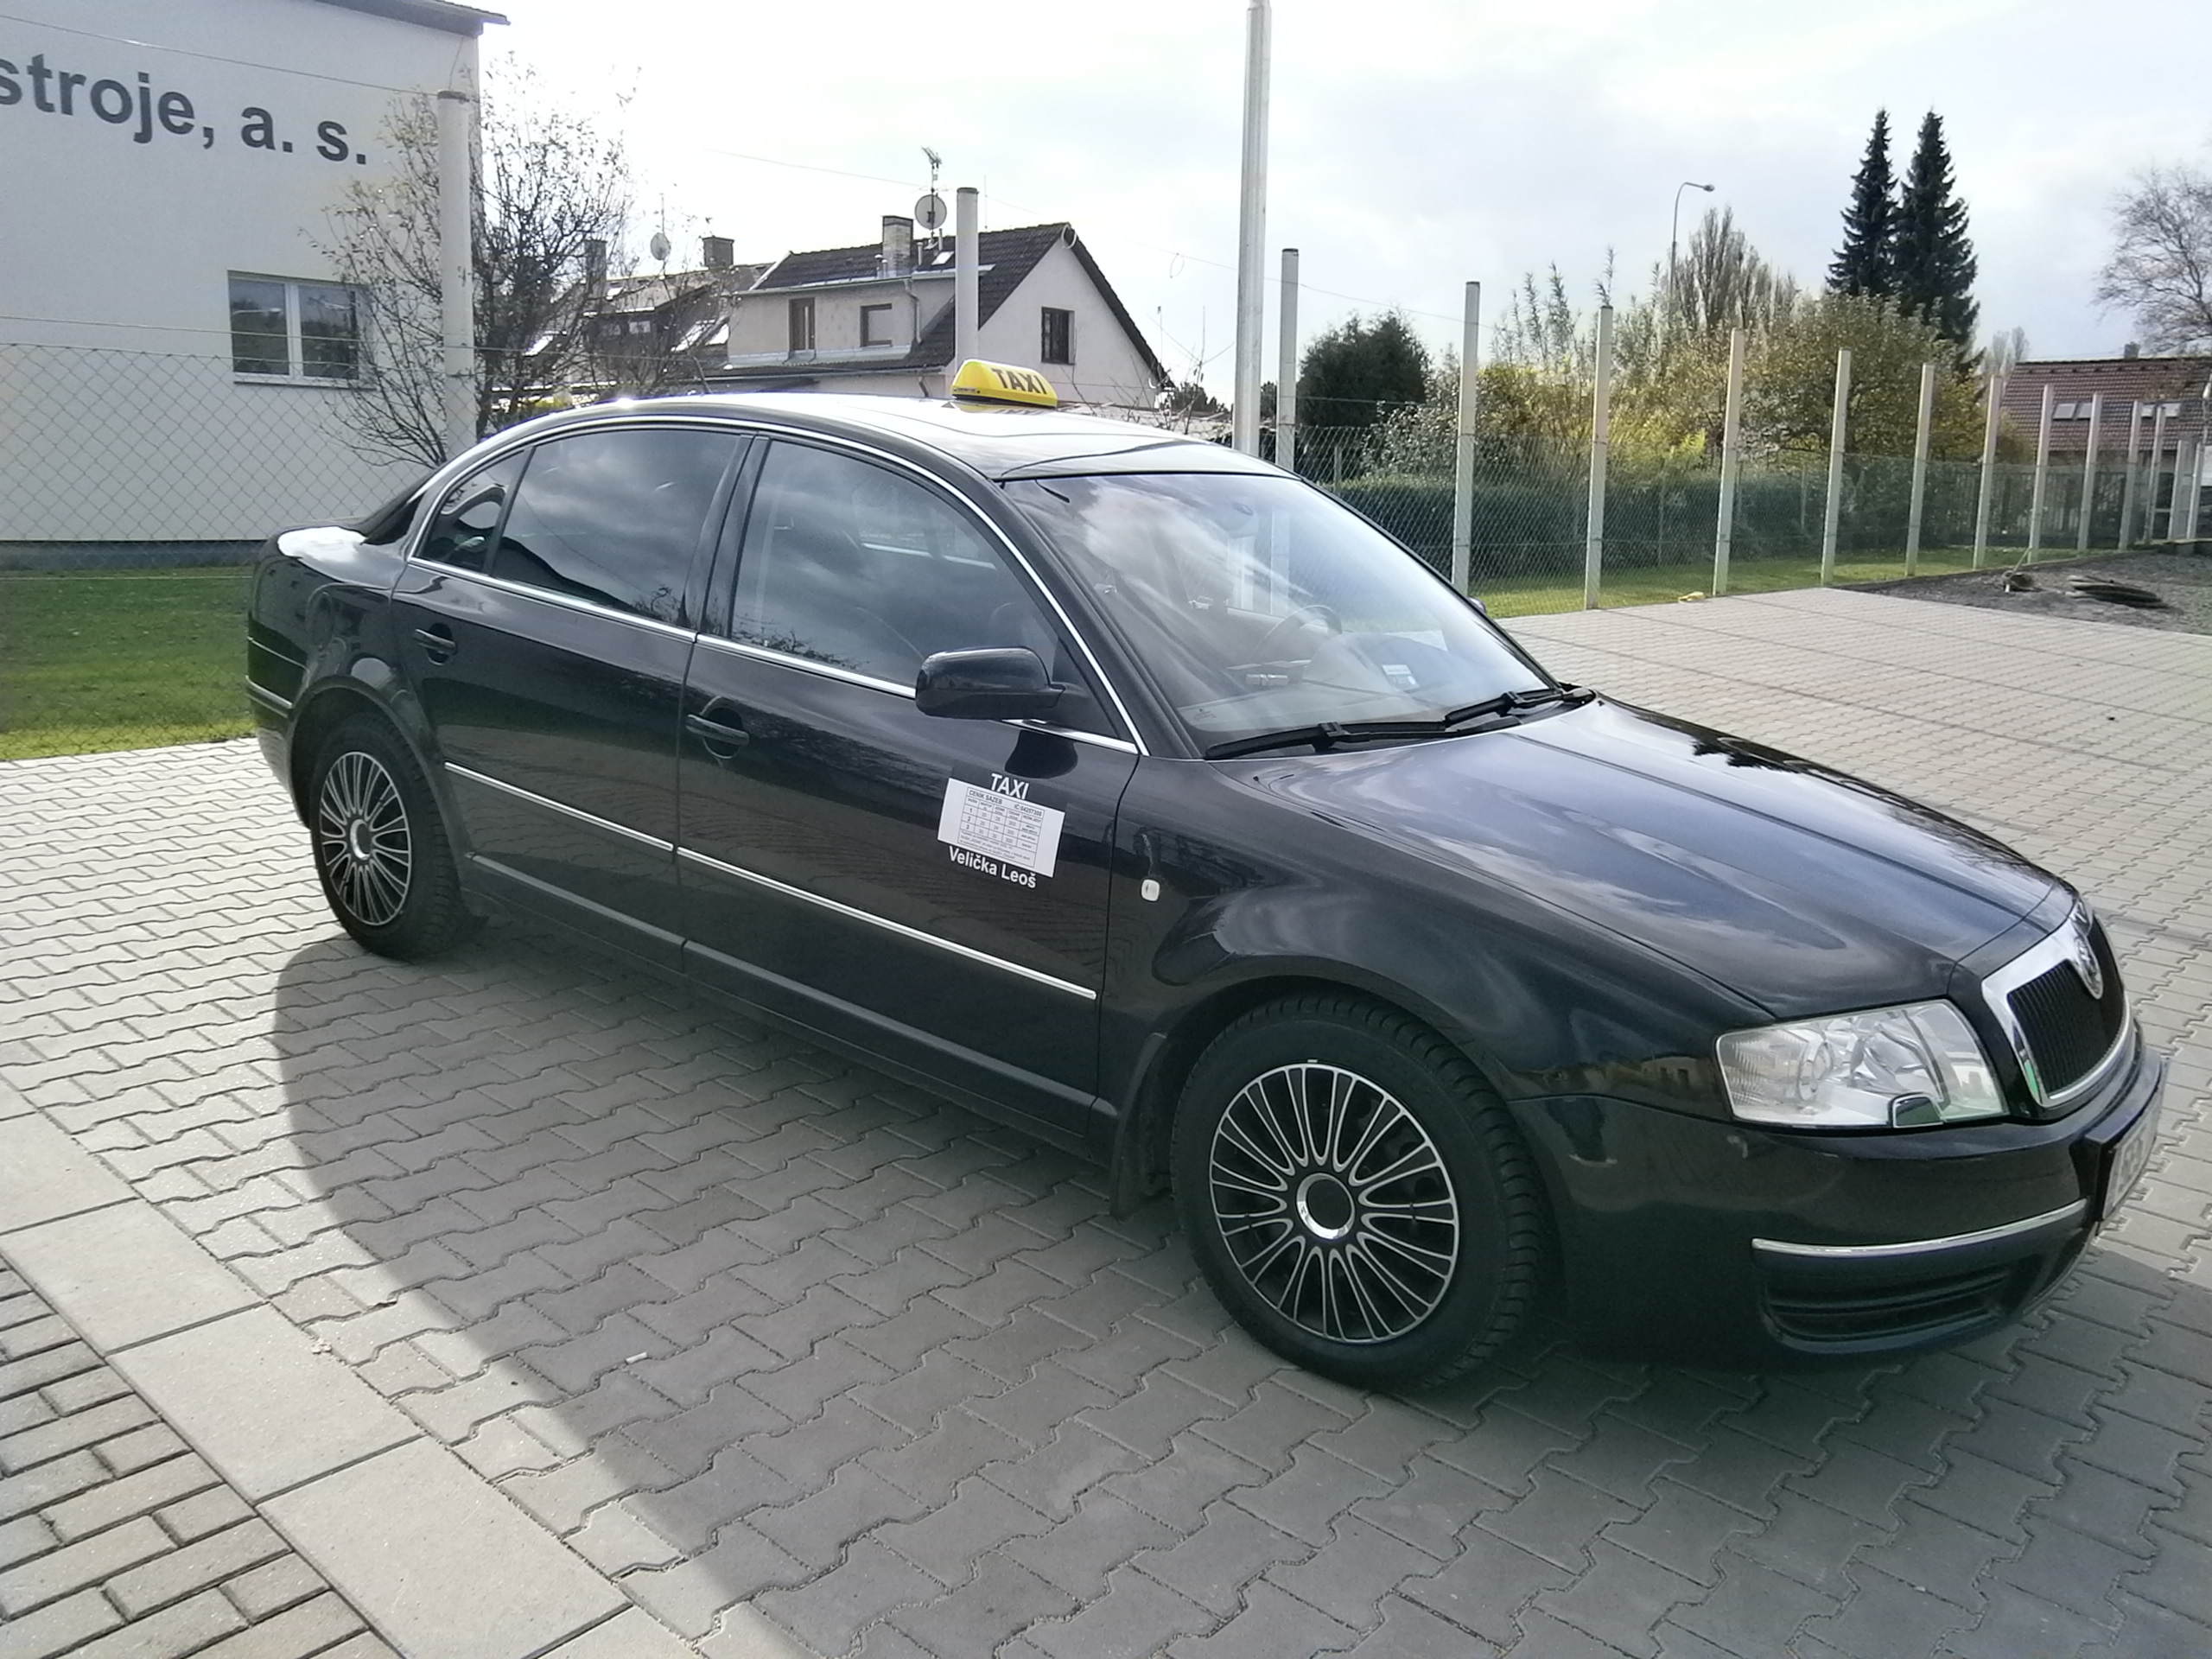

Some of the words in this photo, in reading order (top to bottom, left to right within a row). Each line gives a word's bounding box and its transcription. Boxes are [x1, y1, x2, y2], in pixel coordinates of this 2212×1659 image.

[0, 54, 215, 149] stroje,
[240, 106, 295, 153] a.
[316, 120, 367, 165] s.
[990, 368, 1048, 395] TAXI
[991, 773, 1029, 799] TAXI
[949, 845, 998, 876] Velička
[1001, 863, 1037, 889] Leoš
